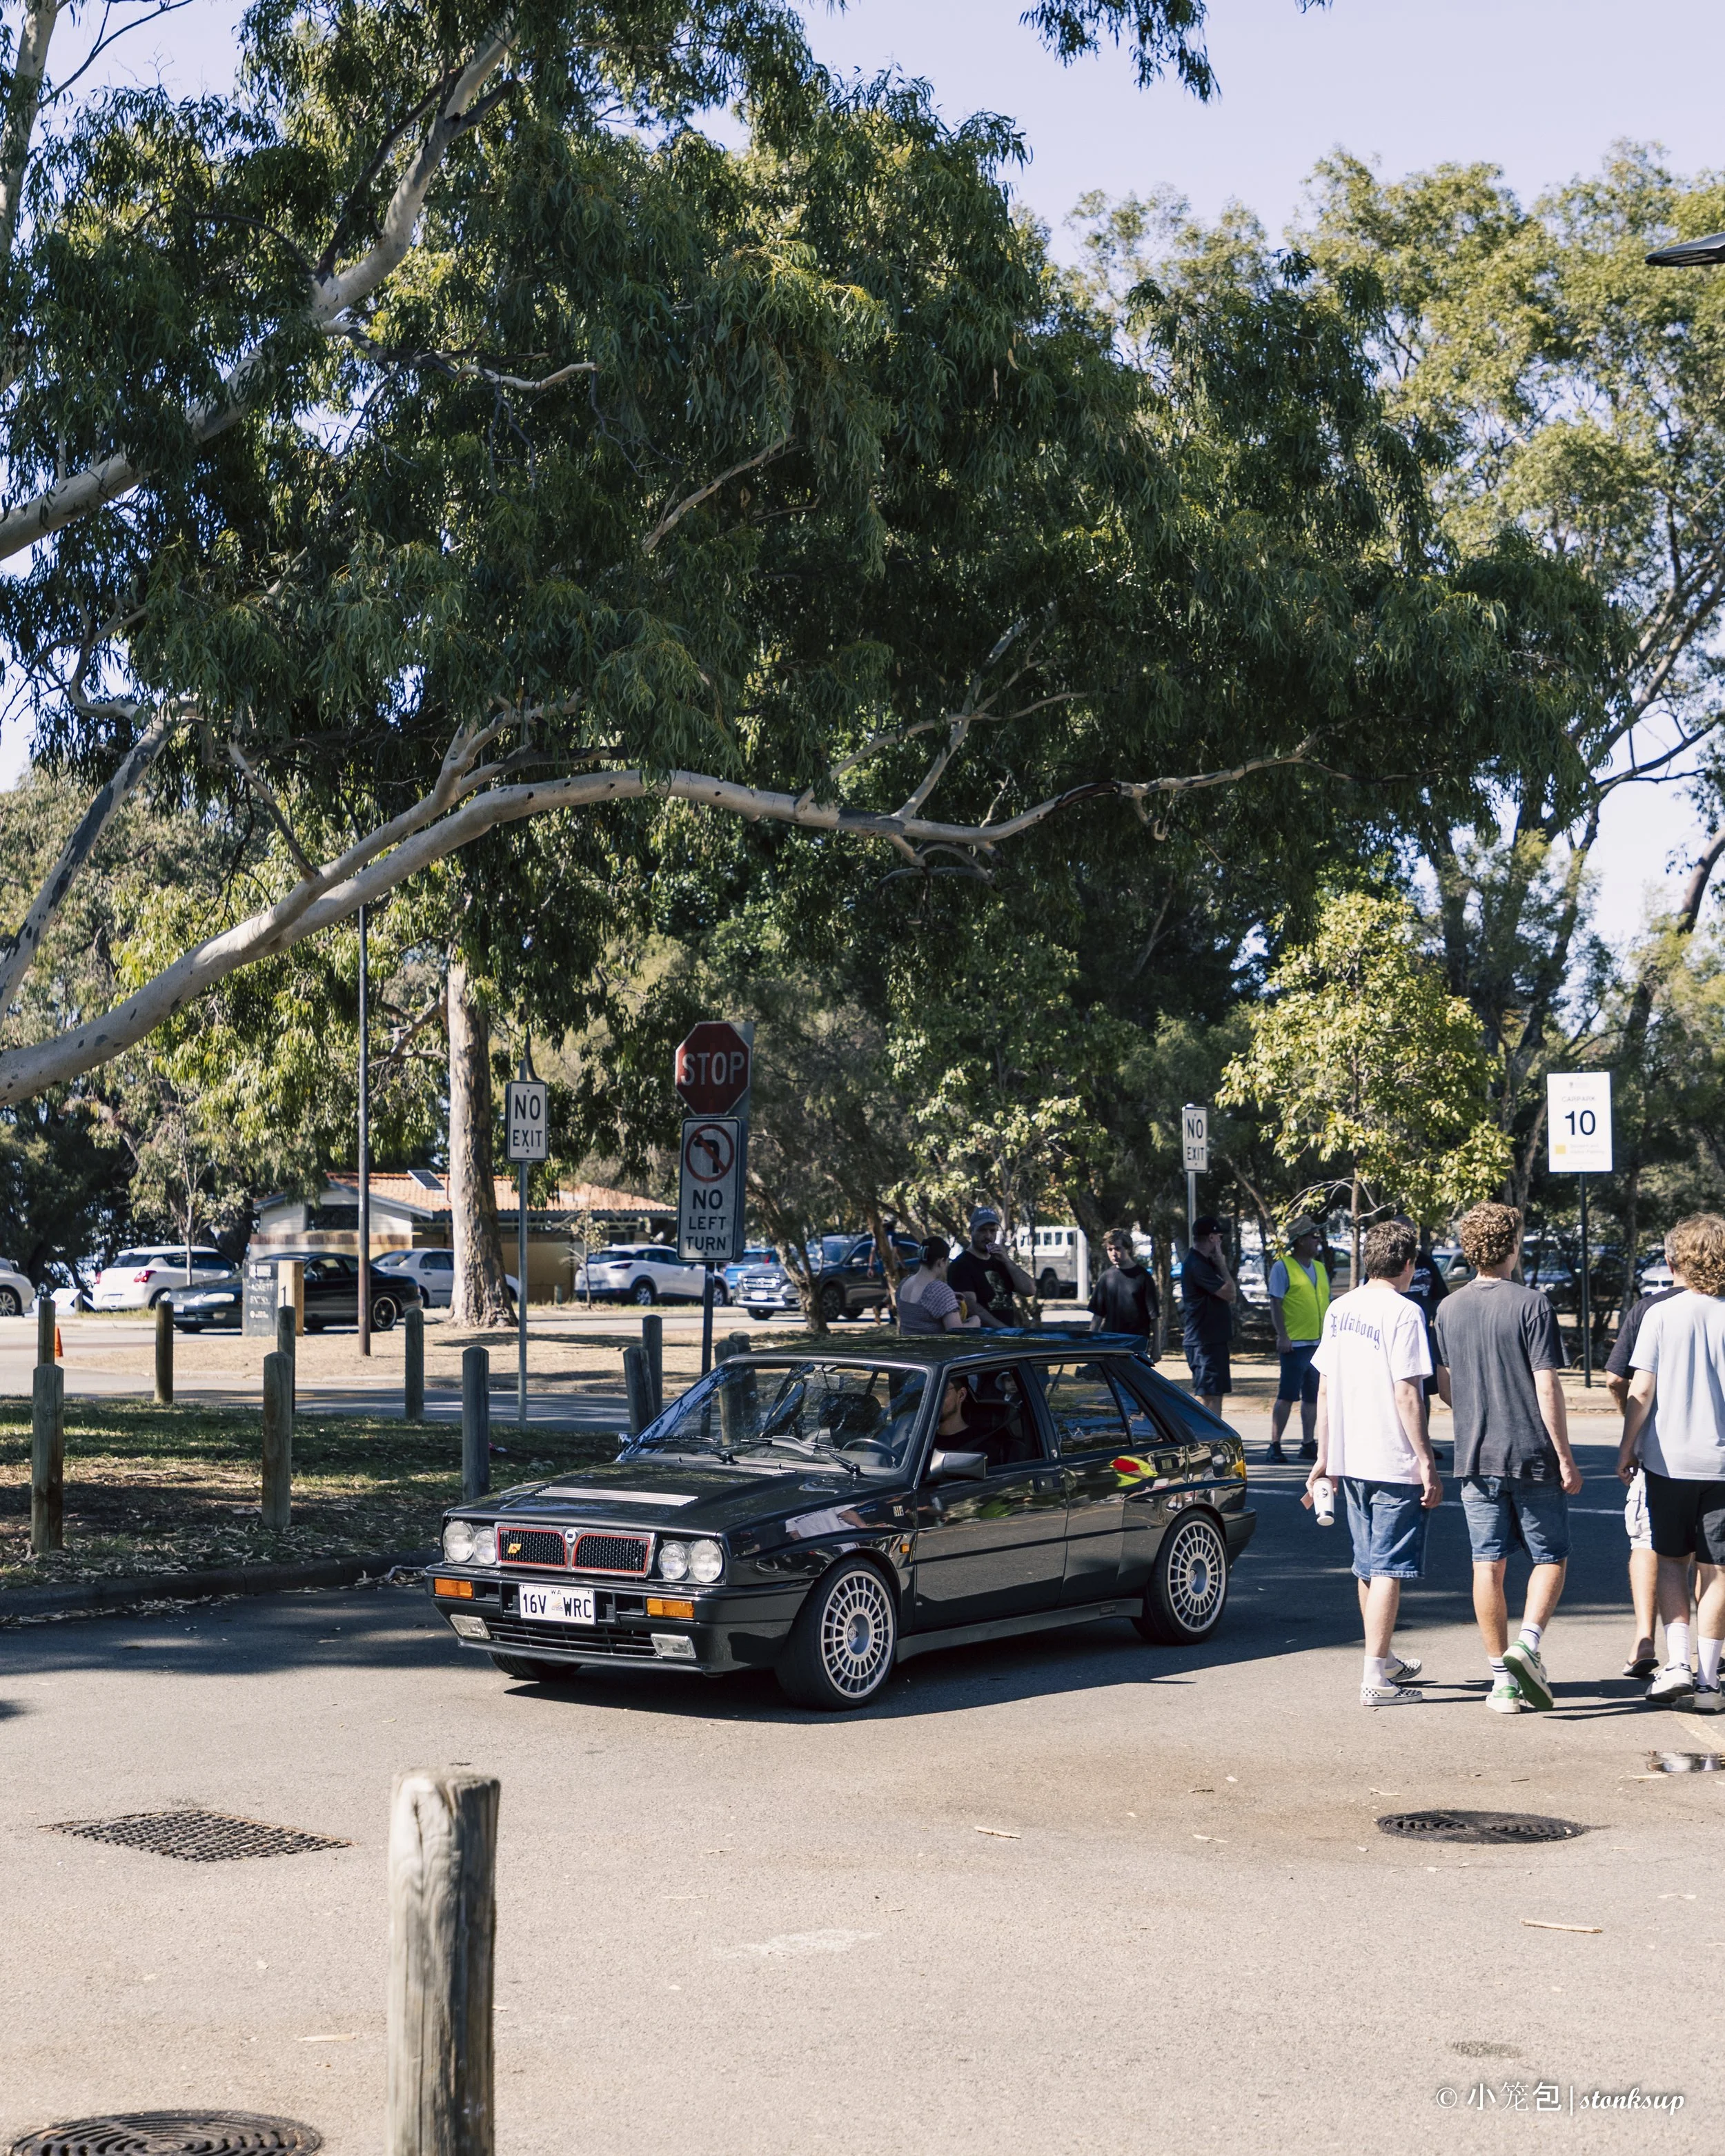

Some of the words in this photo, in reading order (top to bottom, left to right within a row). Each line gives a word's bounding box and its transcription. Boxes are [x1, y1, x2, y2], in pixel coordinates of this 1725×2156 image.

[680, 1051, 745, 1085] STOP
[515, 1094, 541, 1120] NO
[1187, 1118, 1203, 1138] NO
[1565, 1109, 1596, 1136] 10
[513, 1129, 542, 1147] EXIT
[1187, 1147, 1204, 1160] EXIT
[693, 1189, 723, 1210] NO
[689, 1216, 727, 1230] LEFT
[686, 1236, 726, 1250] TURN
[1330, 1312, 1380, 1350] llabong
[523, 1593, 546, 1614] 16V
[562, 1596, 592, 1619] WRC
